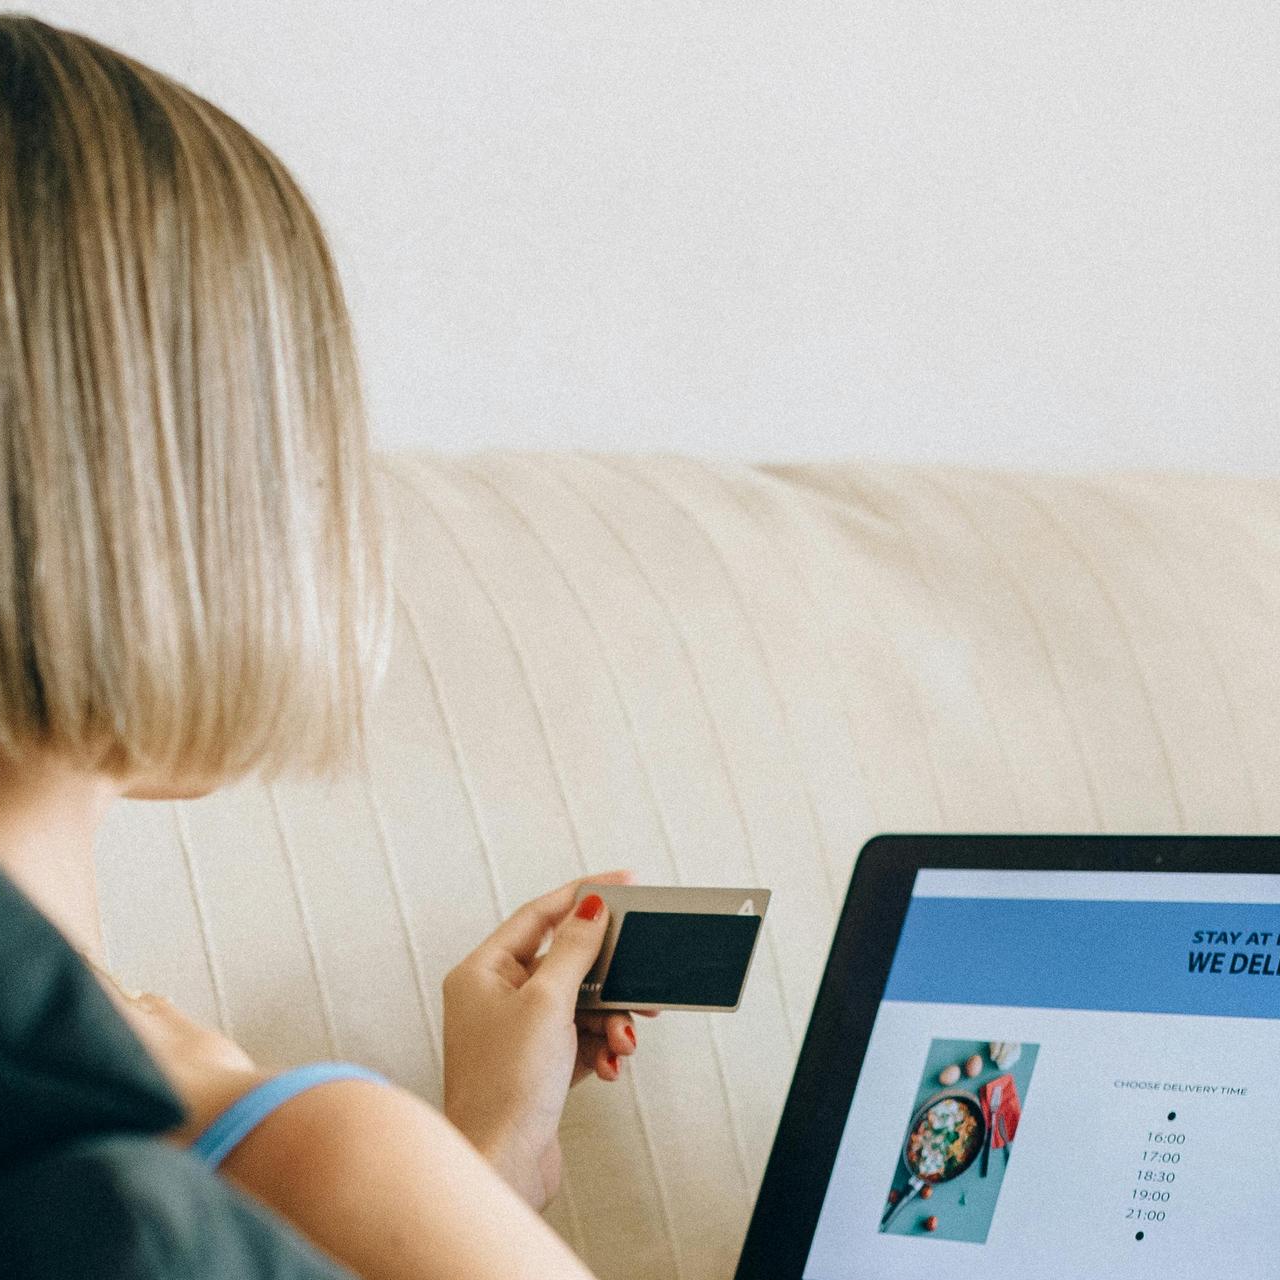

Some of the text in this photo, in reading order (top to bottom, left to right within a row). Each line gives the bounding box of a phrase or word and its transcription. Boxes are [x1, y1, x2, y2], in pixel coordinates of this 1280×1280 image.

[1192, 930, 1241, 945] STAY
[1246, 932, 1273, 946] AT
[1188, 951, 1226, 973] WE
[1113, 1080, 1248, 1096] CHOOSE DELIVERY TIME
[1147, 1132, 1186, 1145] 16:00
[1142, 1151, 1181, 1164] 17:00
[1137, 1170, 1176, 1183] 18:30
[1132, 1189, 1170, 1202] 19:00
[1125, 1208, 1166, 1222] 21:00
